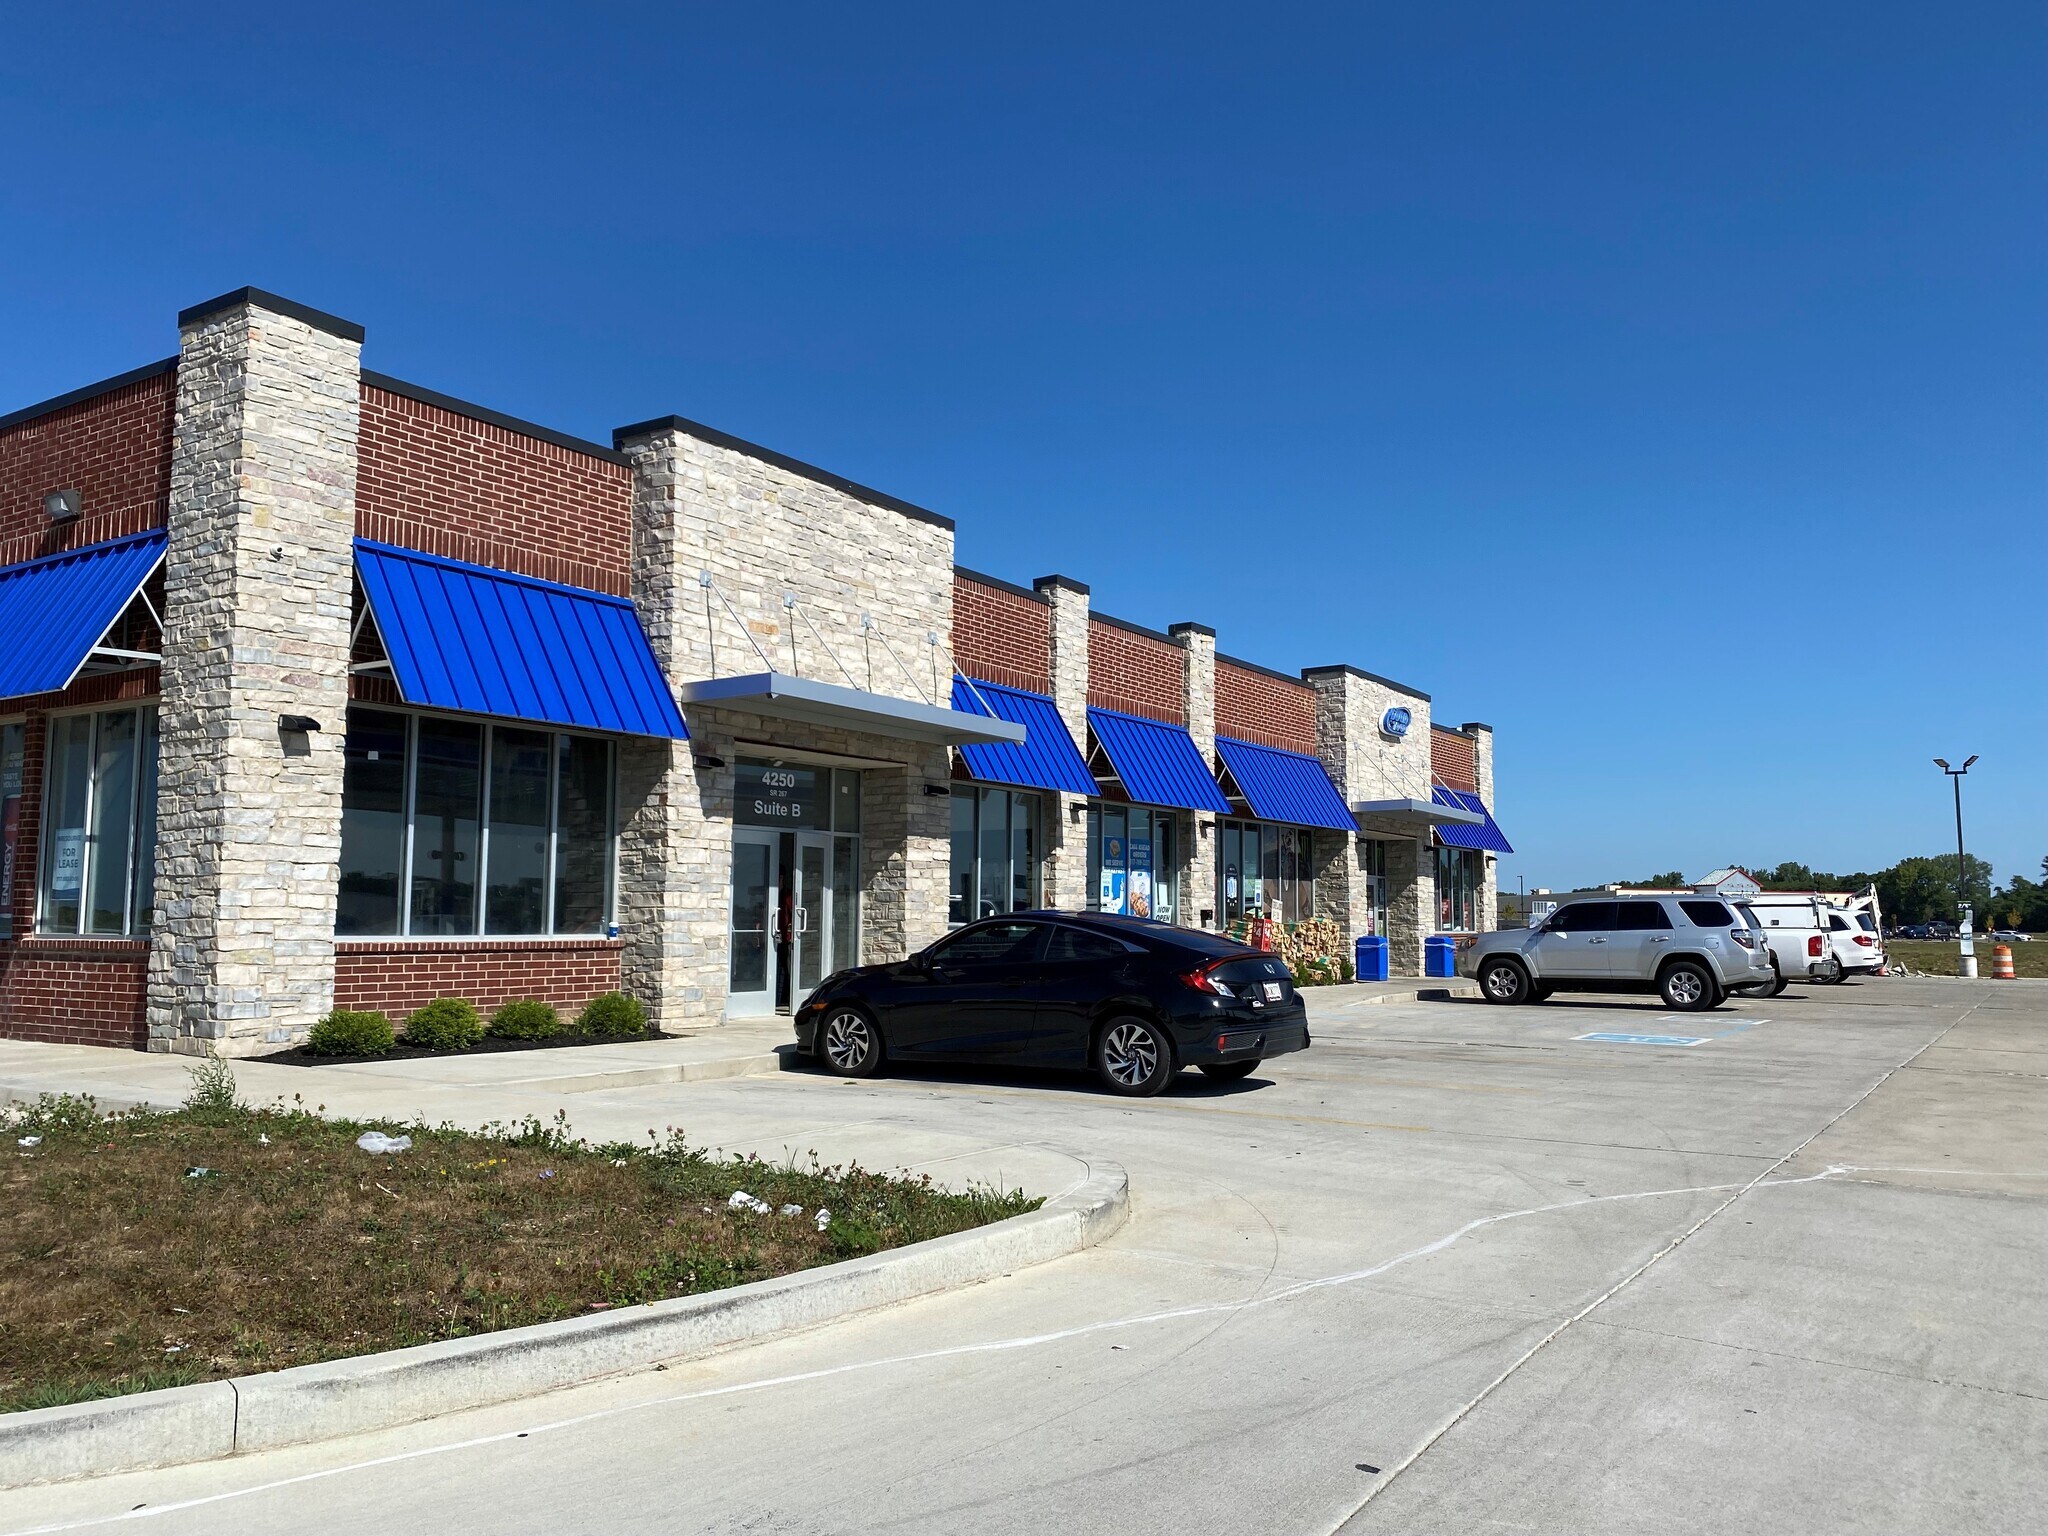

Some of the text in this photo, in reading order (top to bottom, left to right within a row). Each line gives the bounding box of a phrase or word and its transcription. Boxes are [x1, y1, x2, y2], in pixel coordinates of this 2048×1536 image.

[762, 771, 794, 788] 4250
[754, 800, 801, 816] Suite B
[62, 847, 76, 857] FOR
[58, 859, 79, 868] LEASE
[1, 842, 12, 906] ENERGY
